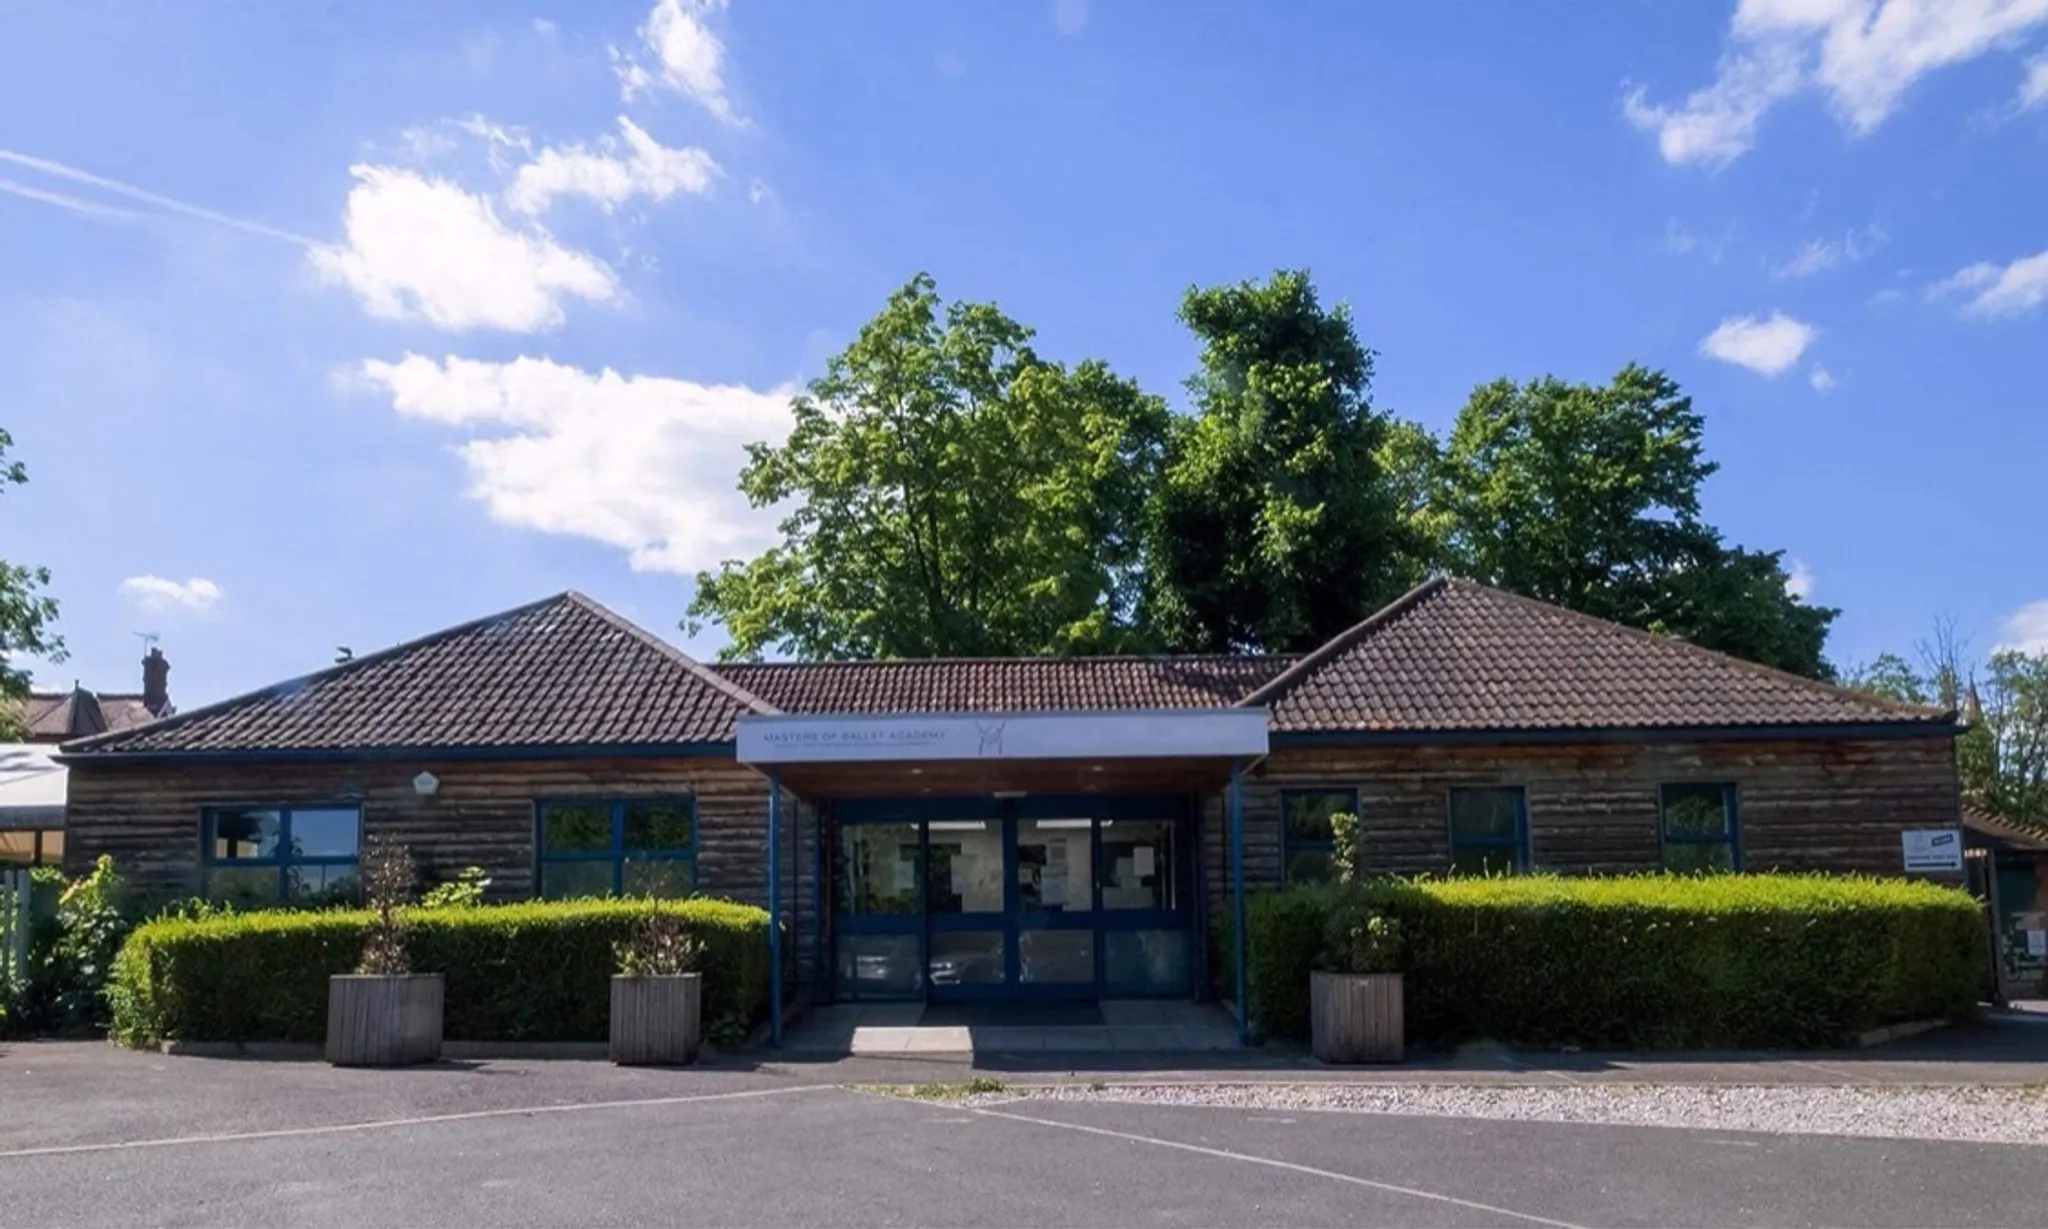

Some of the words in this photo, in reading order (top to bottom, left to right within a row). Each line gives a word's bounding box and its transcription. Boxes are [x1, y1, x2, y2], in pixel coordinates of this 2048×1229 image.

[763, 731, 817, 742] MASTERS
[821, 731, 836, 741] OF
[841, 731, 884, 741] BALLET
[888, 730, 946, 740] ACADEMY
